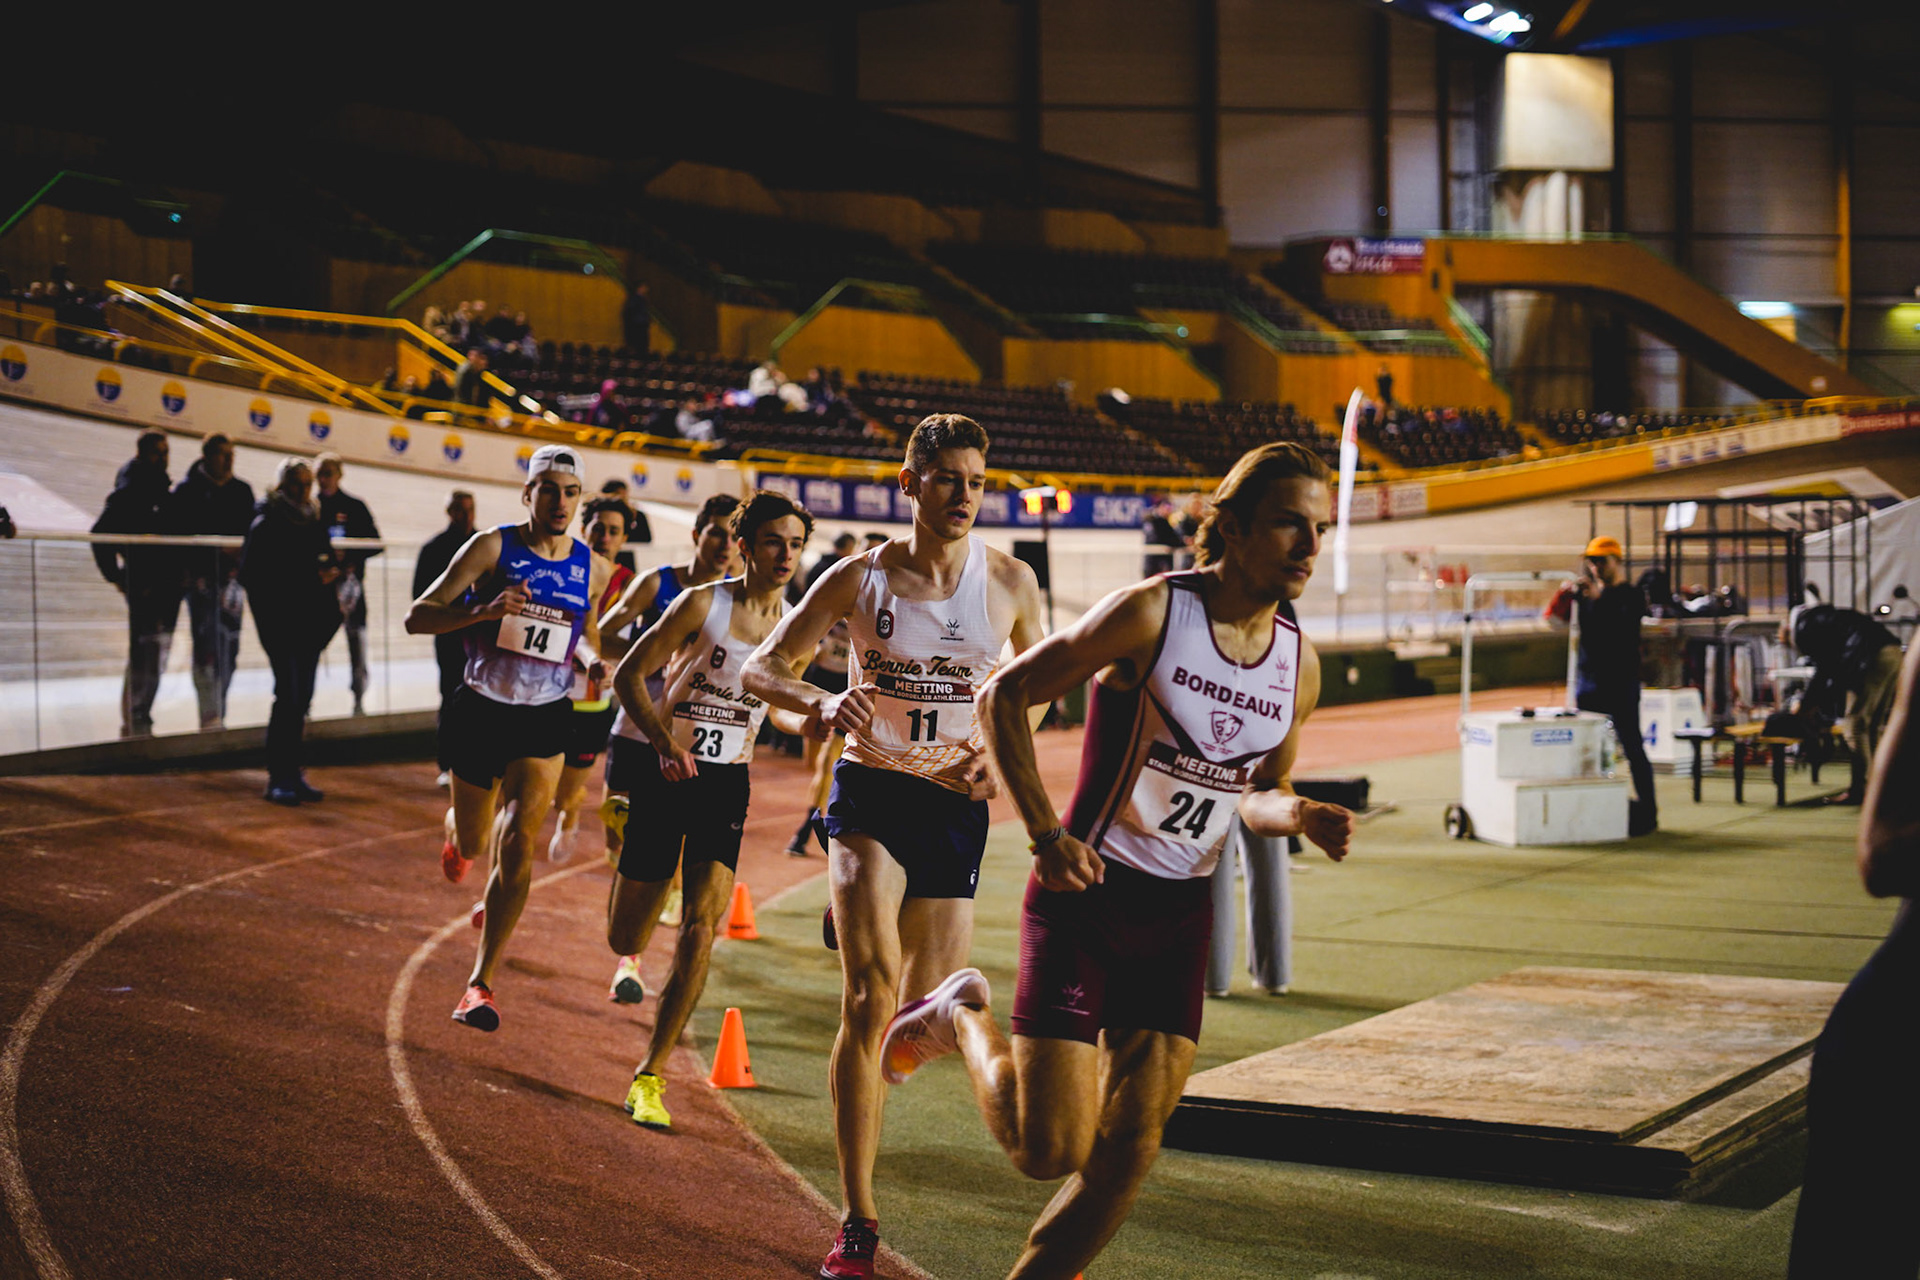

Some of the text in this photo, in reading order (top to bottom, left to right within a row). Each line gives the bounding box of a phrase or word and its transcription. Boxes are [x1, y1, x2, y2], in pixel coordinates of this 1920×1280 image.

[524, 625, 551, 654] 14
[862, 649, 973, 678] Bernie Team
[688, 672, 732, 701] Bernie
[895, 680, 954, 694] MEETING
[897, 691, 932, 701] BORDELAIS
[933, 693, 972, 702] ATHLÉTISME
[1171, 666, 1283, 722] BORDEAUX
[690, 704, 736, 719] MEETING
[906, 708, 938, 742] 11
[690, 727, 724, 758] 23
[1147, 757, 1173, 773] STADE
[1173, 767, 1214, 786] BORDELAIS
[1174, 753, 1238, 782] MEETING
[1158, 791, 1216, 840] 24
